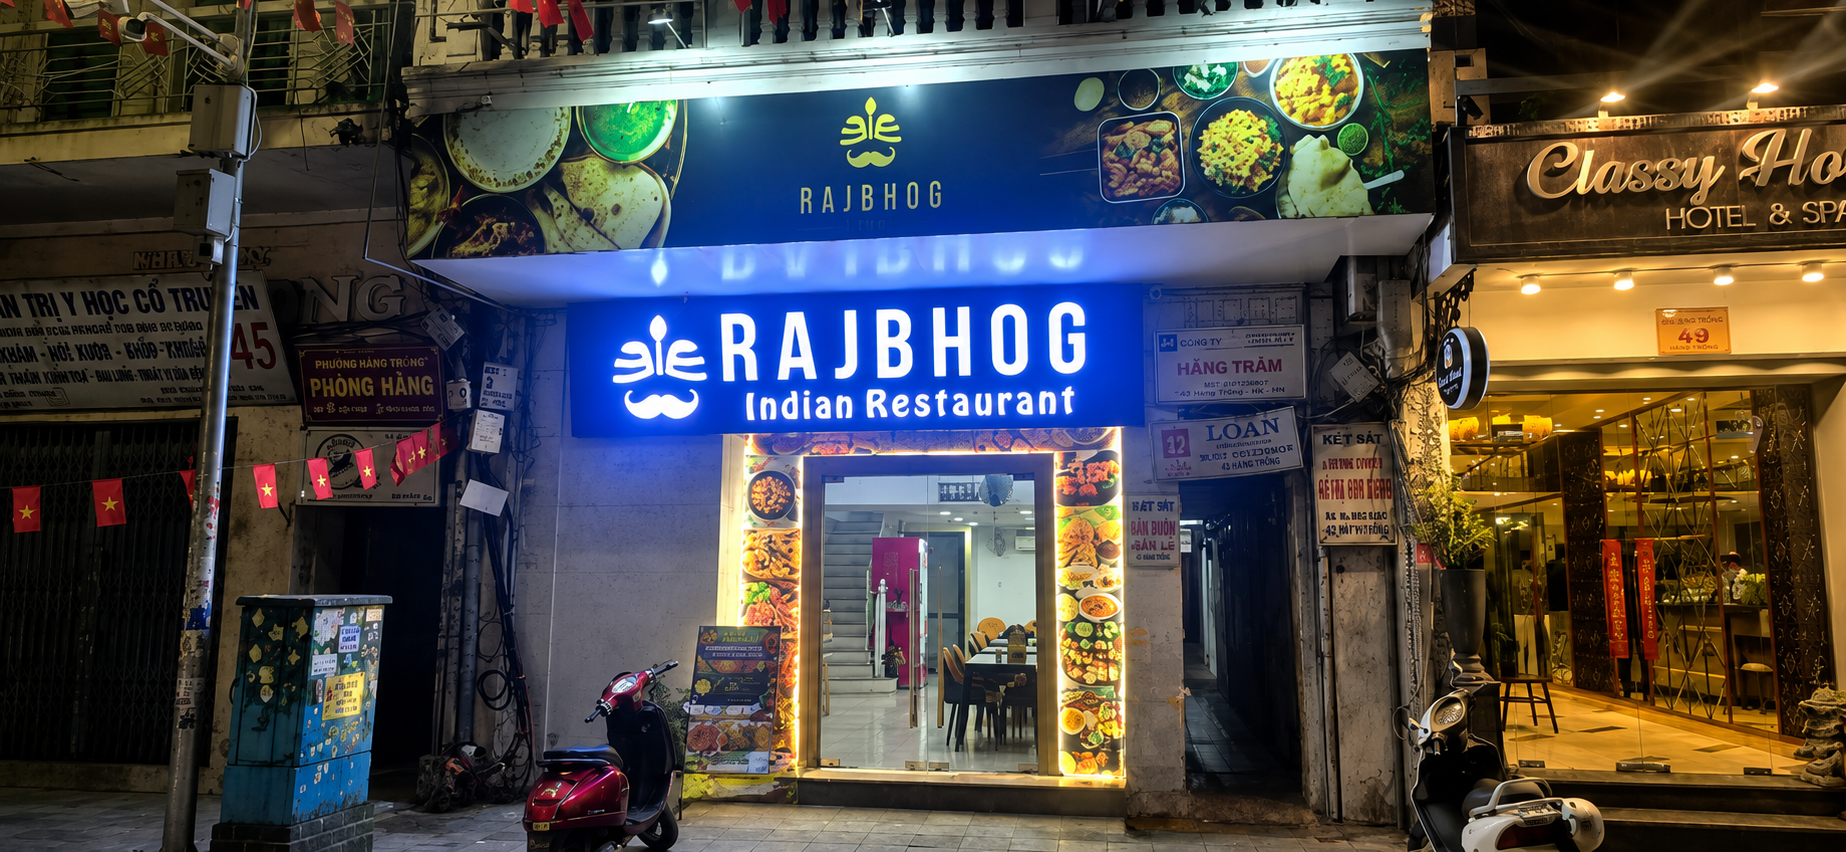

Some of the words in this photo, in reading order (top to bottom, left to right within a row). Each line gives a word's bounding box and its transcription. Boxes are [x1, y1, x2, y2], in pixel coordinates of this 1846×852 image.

[1527, 141, 1726, 206] Classy
[800, 180, 942, 214] RAJBHOG
[1665, 204, 1757, 230] HOTEL
[1769, 203, 1793, 226] &
[60, 291, 77, 316] Y
[80, 289, 130, 321] HỌC
[132, 278, 167, 314] CỔ
[231, 321, 277, 370] 45
[720, 302, 1087, 382] RAJBHOG
[1209, 337, 1222, 346] TY
[1677, 327, 1710, 344] 49
[745, 388, 854, 421] Indian
[865, 385, 1075, 420] Restaurant
[1205, 417, 1280, 442] LOAN
